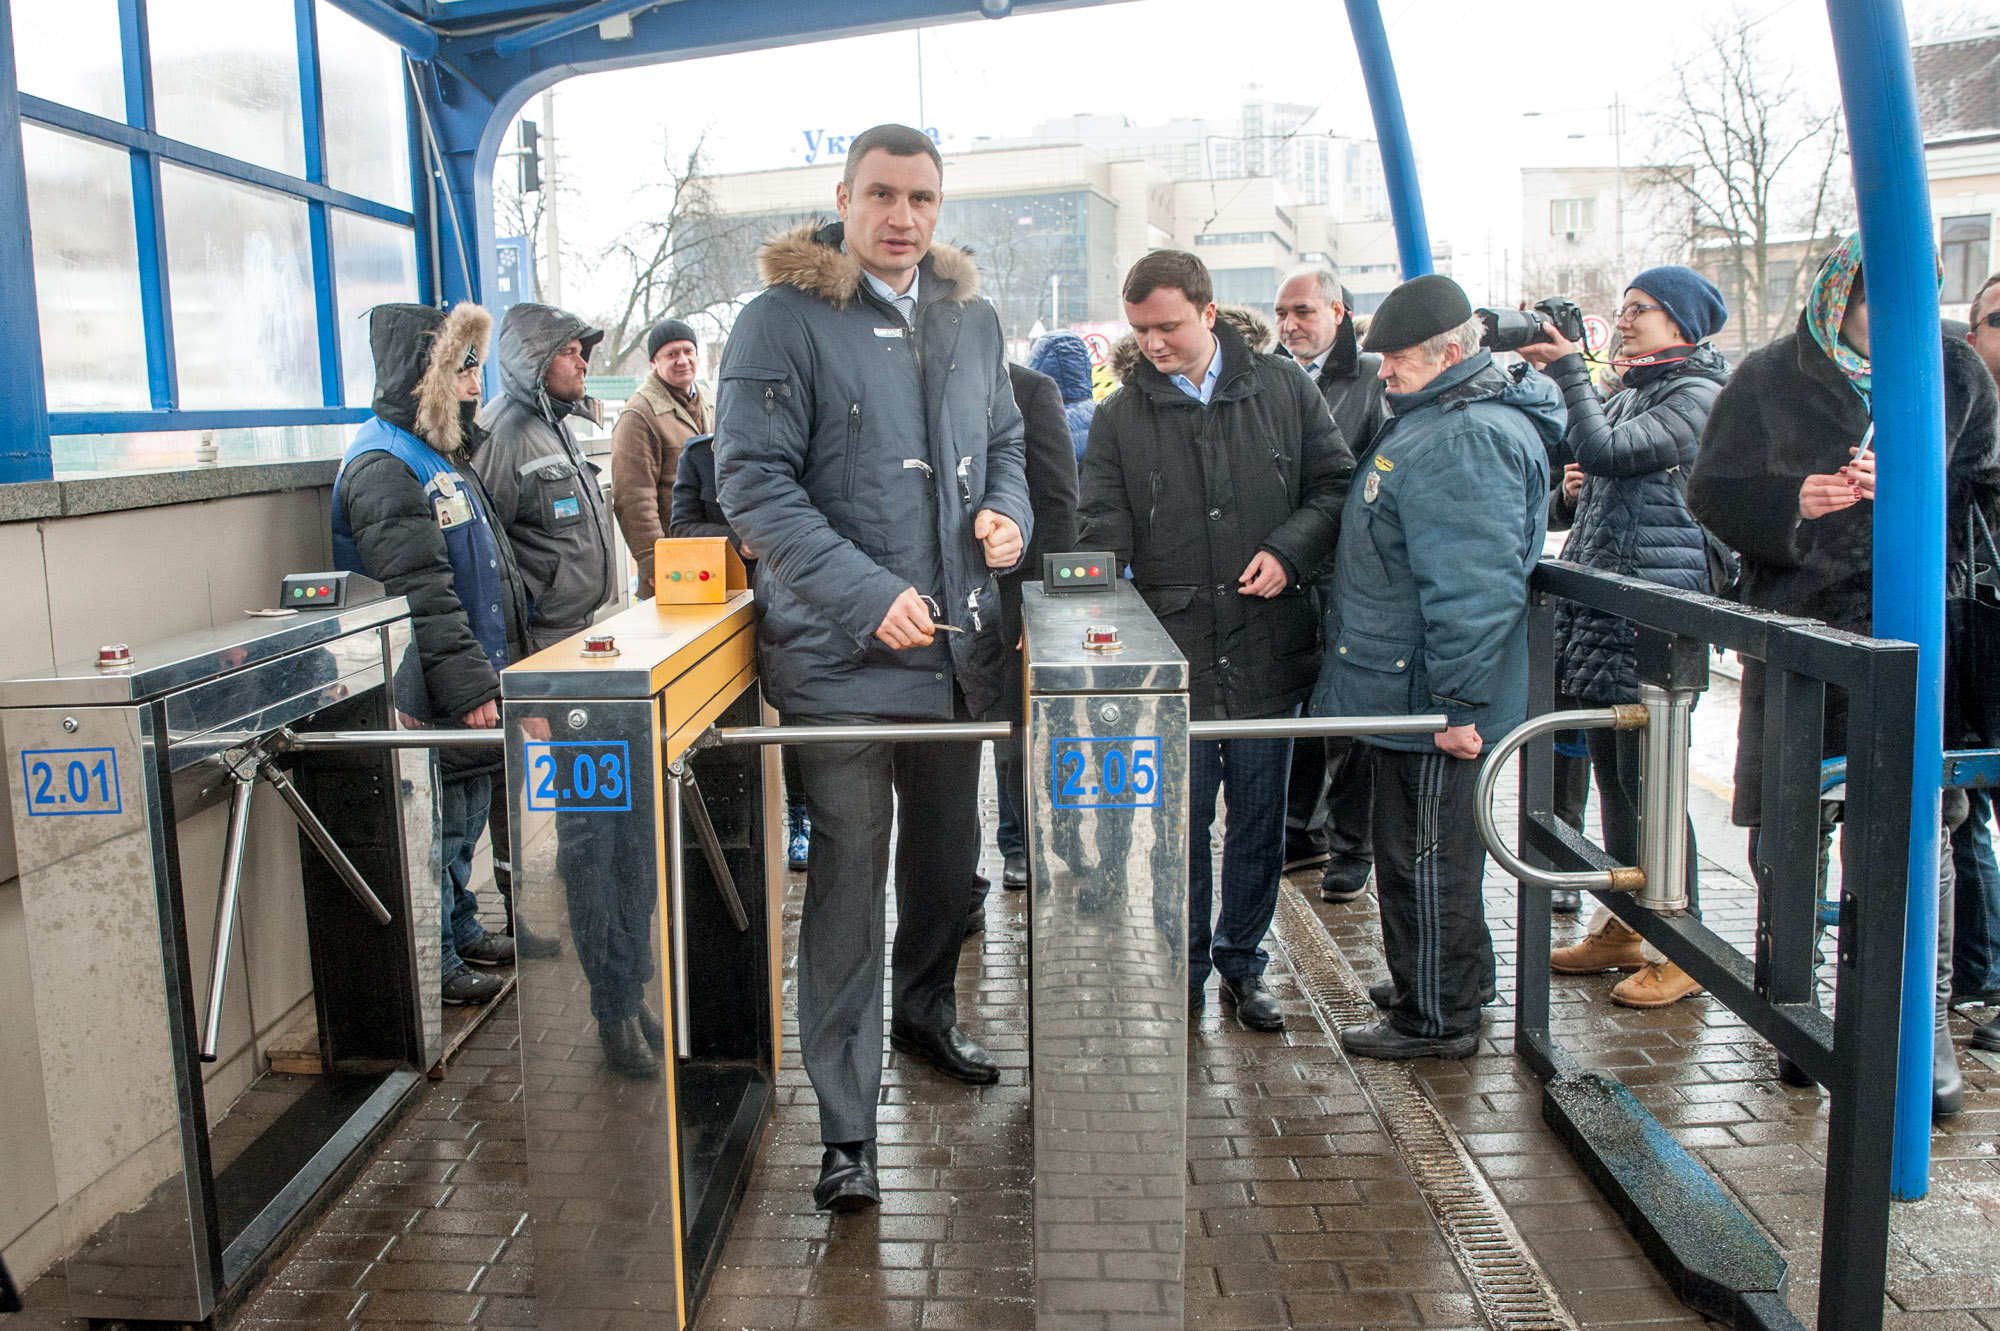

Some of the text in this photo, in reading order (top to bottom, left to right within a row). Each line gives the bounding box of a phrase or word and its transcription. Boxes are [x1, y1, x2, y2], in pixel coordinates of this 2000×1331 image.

[32, 759, 109, 804] 2.01
[534, 753, 623, 799] 2.03
[1062, 750, 1154, 796] 2.05
